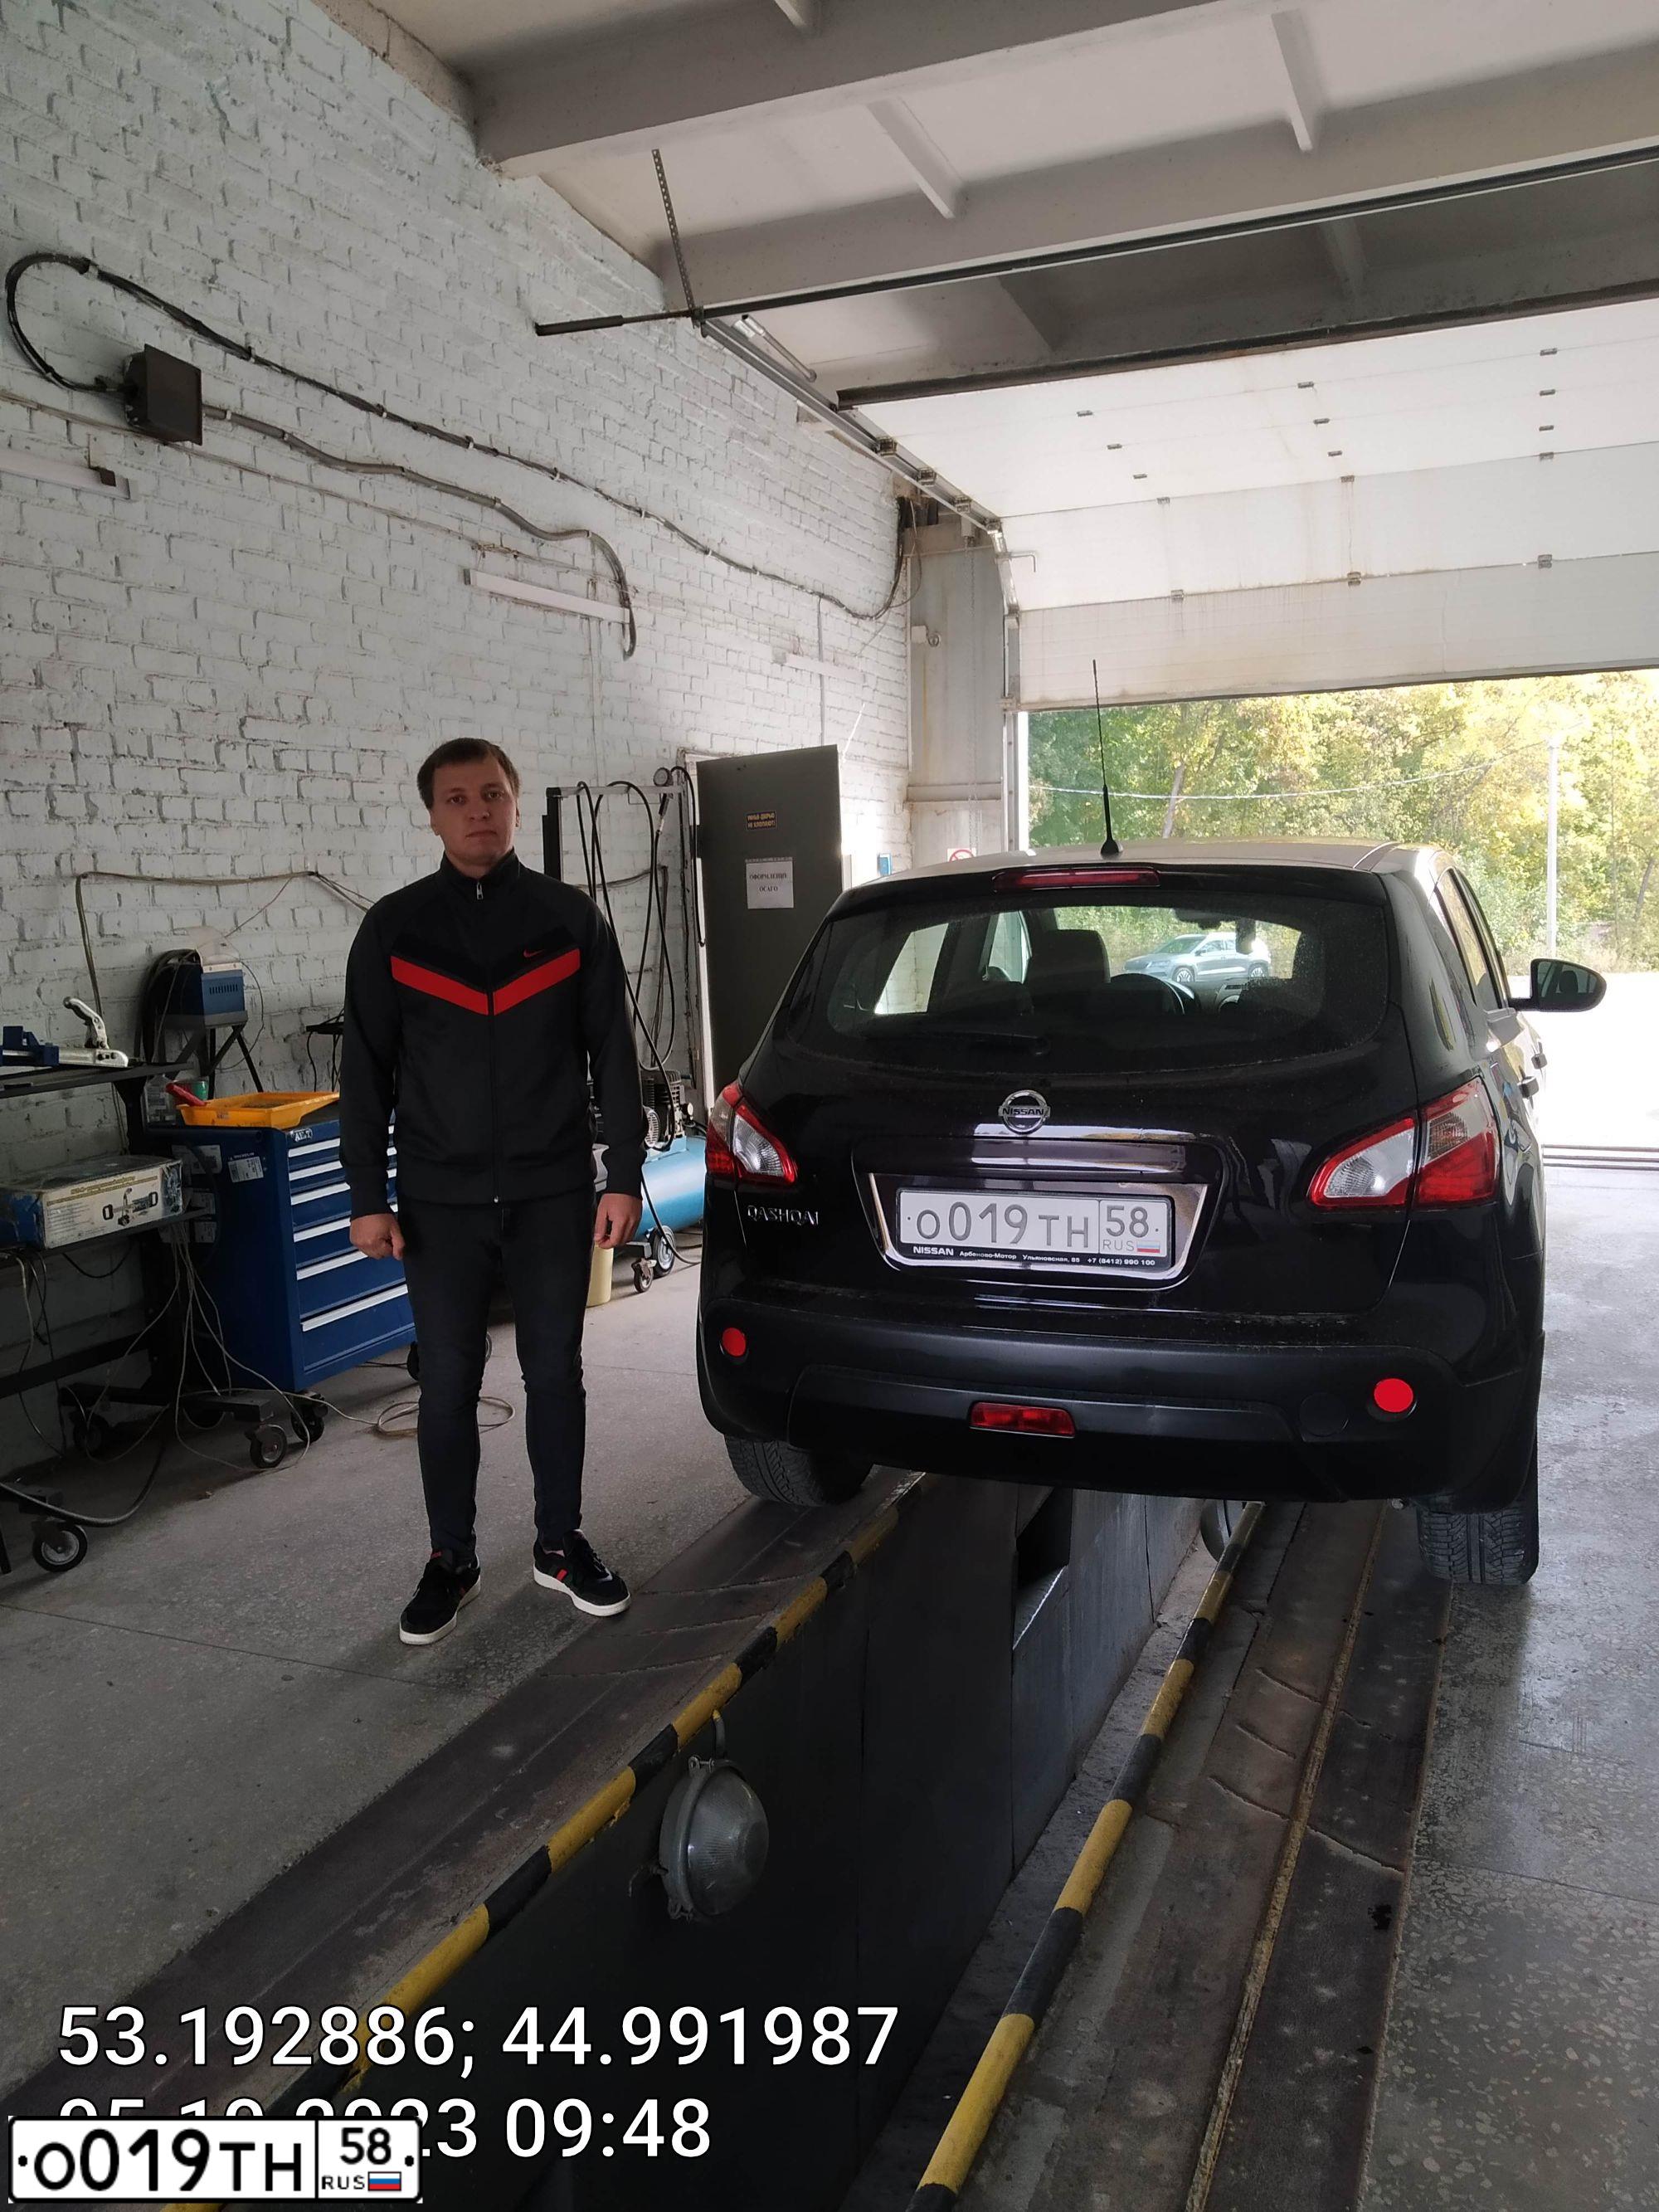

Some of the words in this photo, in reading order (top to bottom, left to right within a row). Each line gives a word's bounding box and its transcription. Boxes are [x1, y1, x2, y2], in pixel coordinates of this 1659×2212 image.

[759, 884, 778, 893] ОСАГО
[747, 1205, 819, 1225] QASHQAI
[1105, 1205, 1150, 1238] 58
[913, 1245, 954, 1256] NISSAN
[1102, 1239, 1135, 1251] RUS
